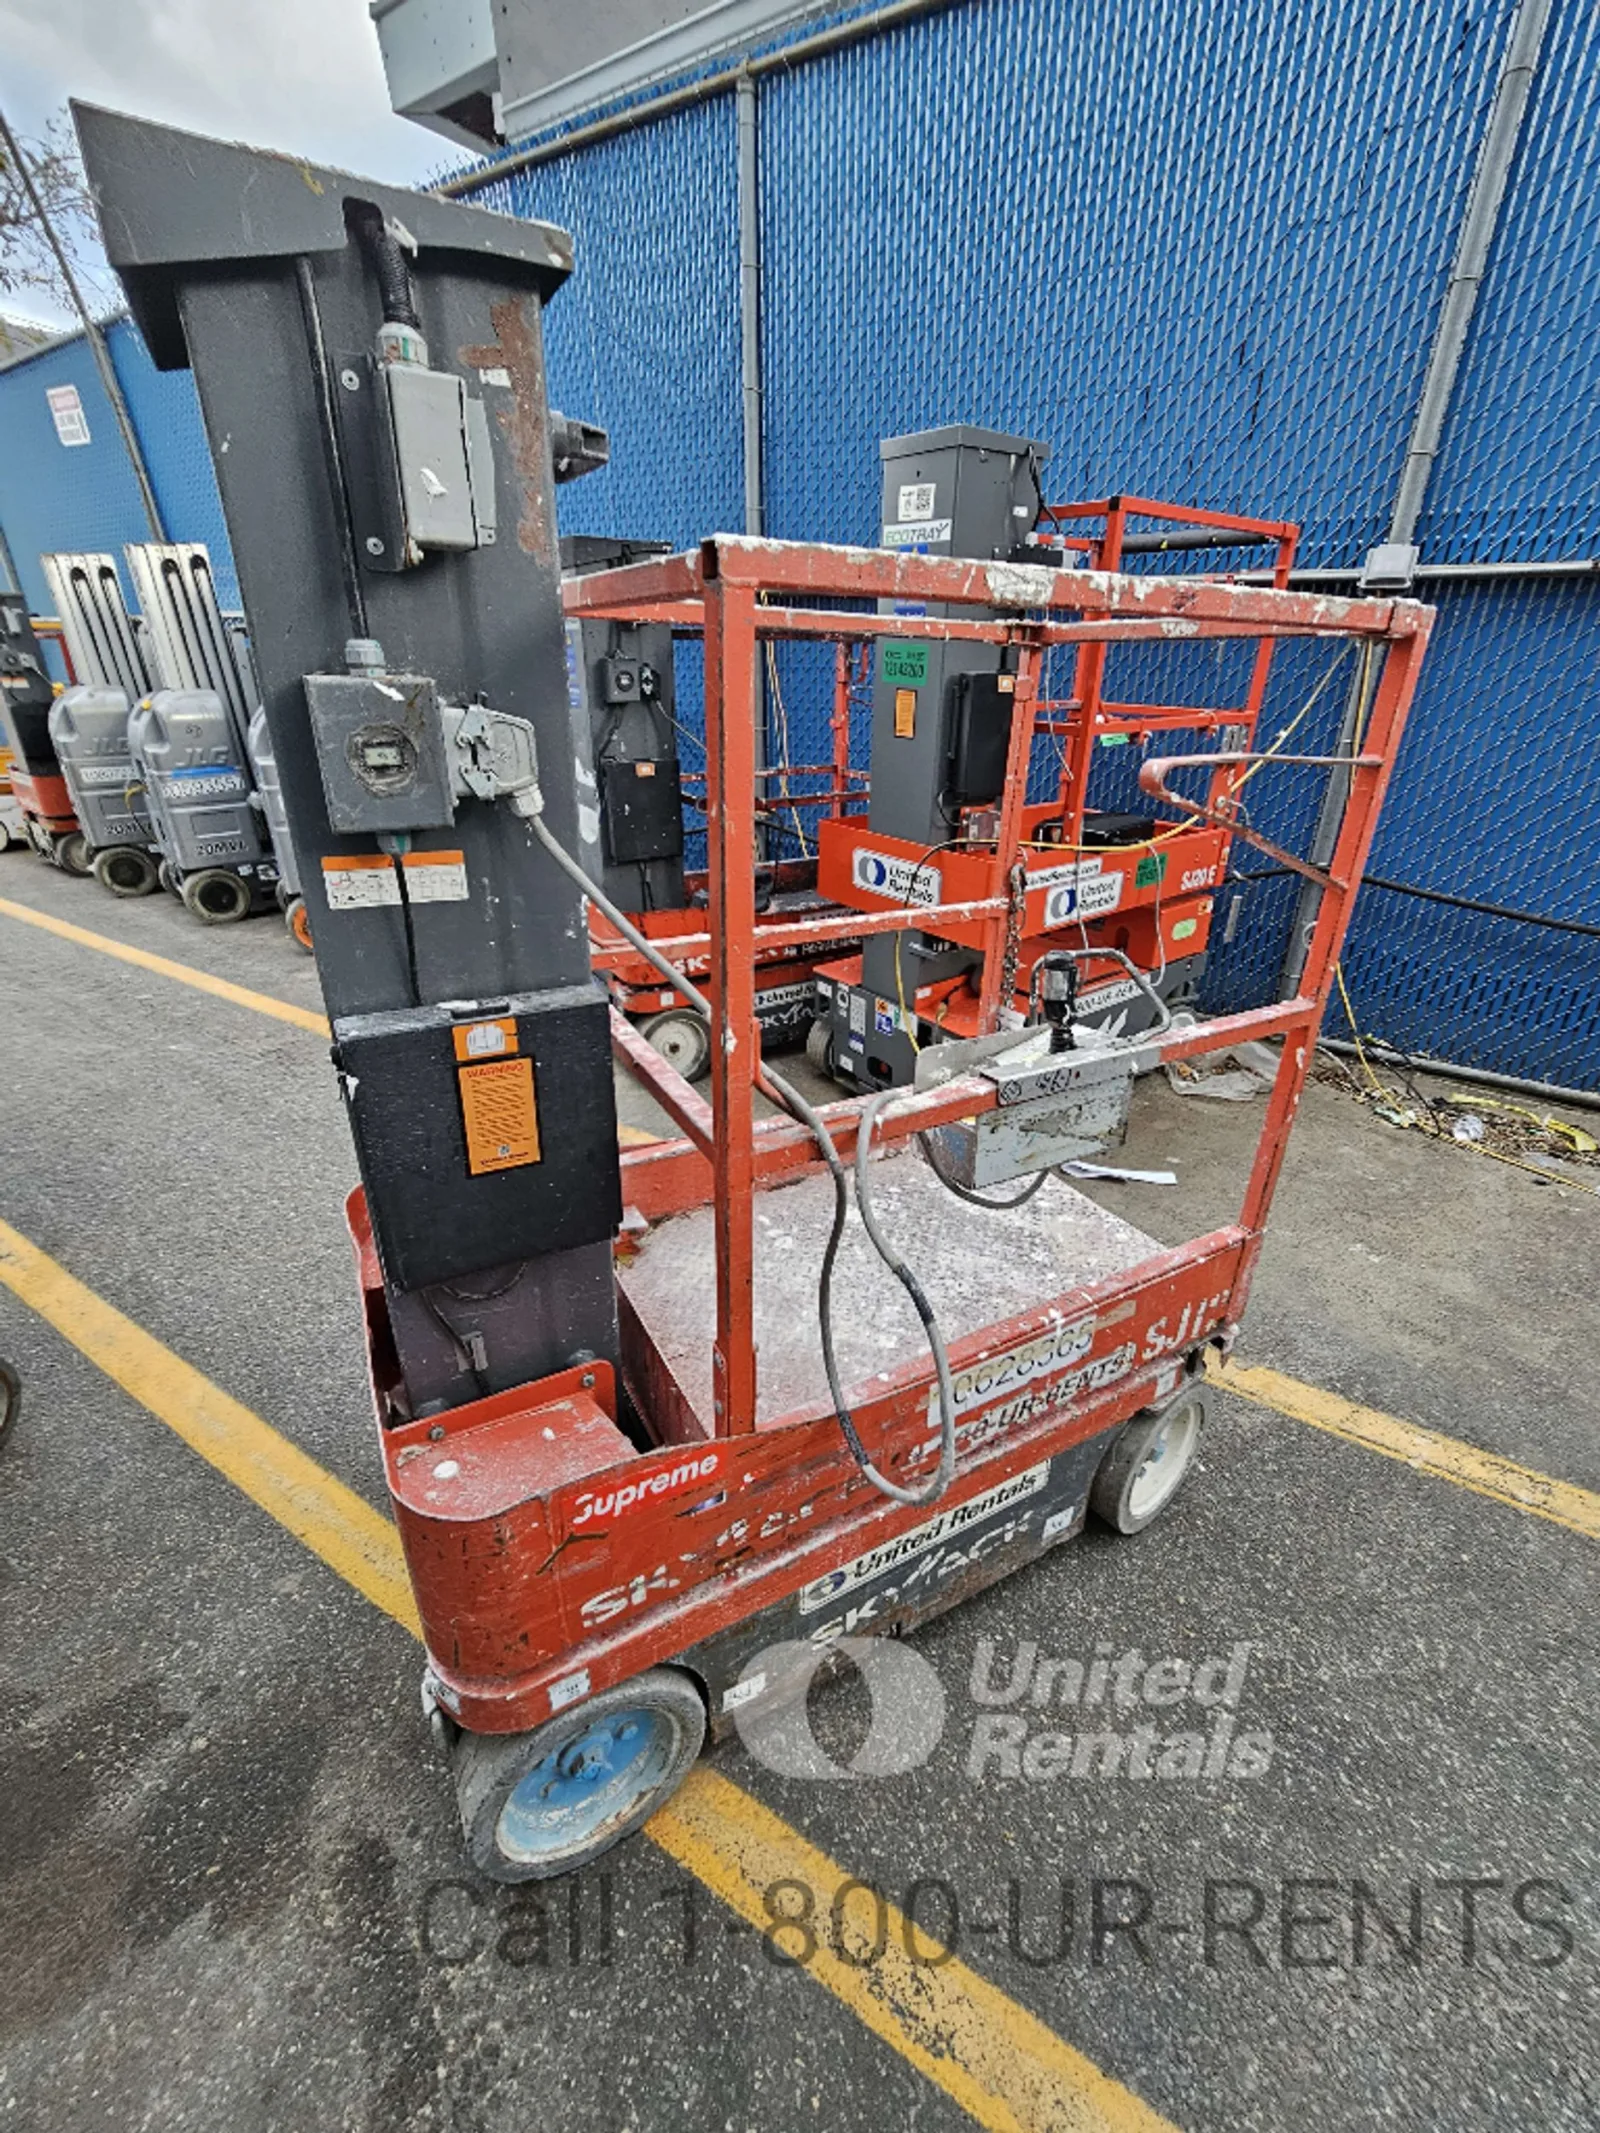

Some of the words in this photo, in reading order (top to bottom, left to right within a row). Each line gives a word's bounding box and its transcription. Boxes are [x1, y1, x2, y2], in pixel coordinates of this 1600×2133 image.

[174, 745, 230, 767] JLG
[889, 864, 934, 887] United
[1081, 878, 1117, 898] United
[888, 879, 935, 904] Rentals
[932, 1319, 1094, 1406] 0628365
[573, 1454, 719, 1525] Supreme
[853, 1514, 943, 1579] United
[948, 1471, 1037, 1530] Rentals
